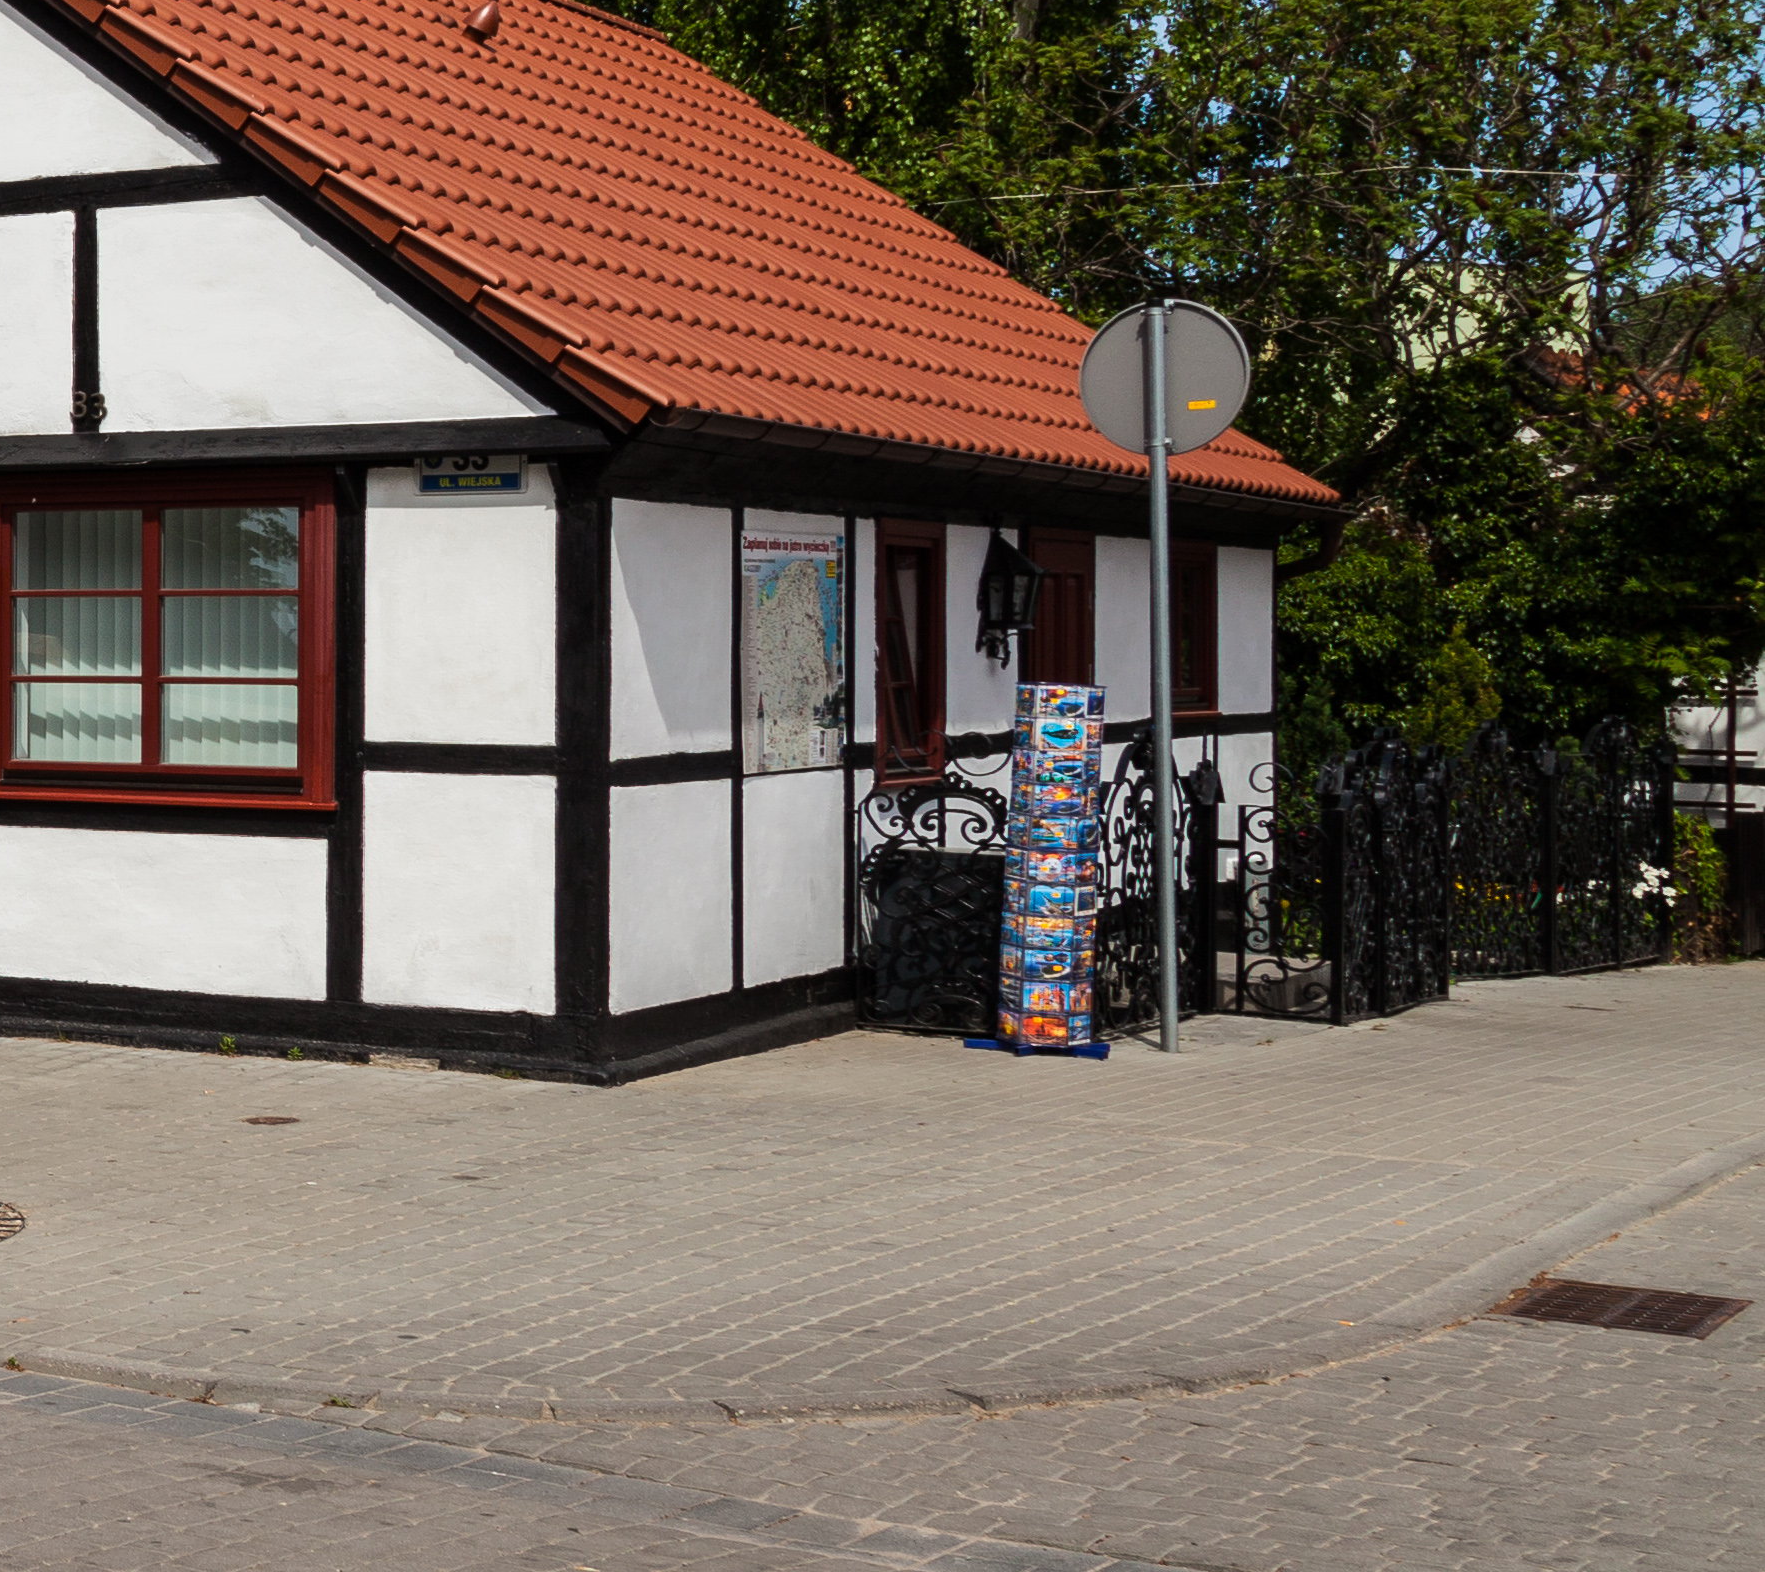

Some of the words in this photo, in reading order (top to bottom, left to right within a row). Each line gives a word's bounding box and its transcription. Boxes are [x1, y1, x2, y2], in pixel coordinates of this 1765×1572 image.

[69, 391, 108, 420] 33
[439, 477, 455, 488] UL.
[458, 476, 502, 487] WIEJSKA
